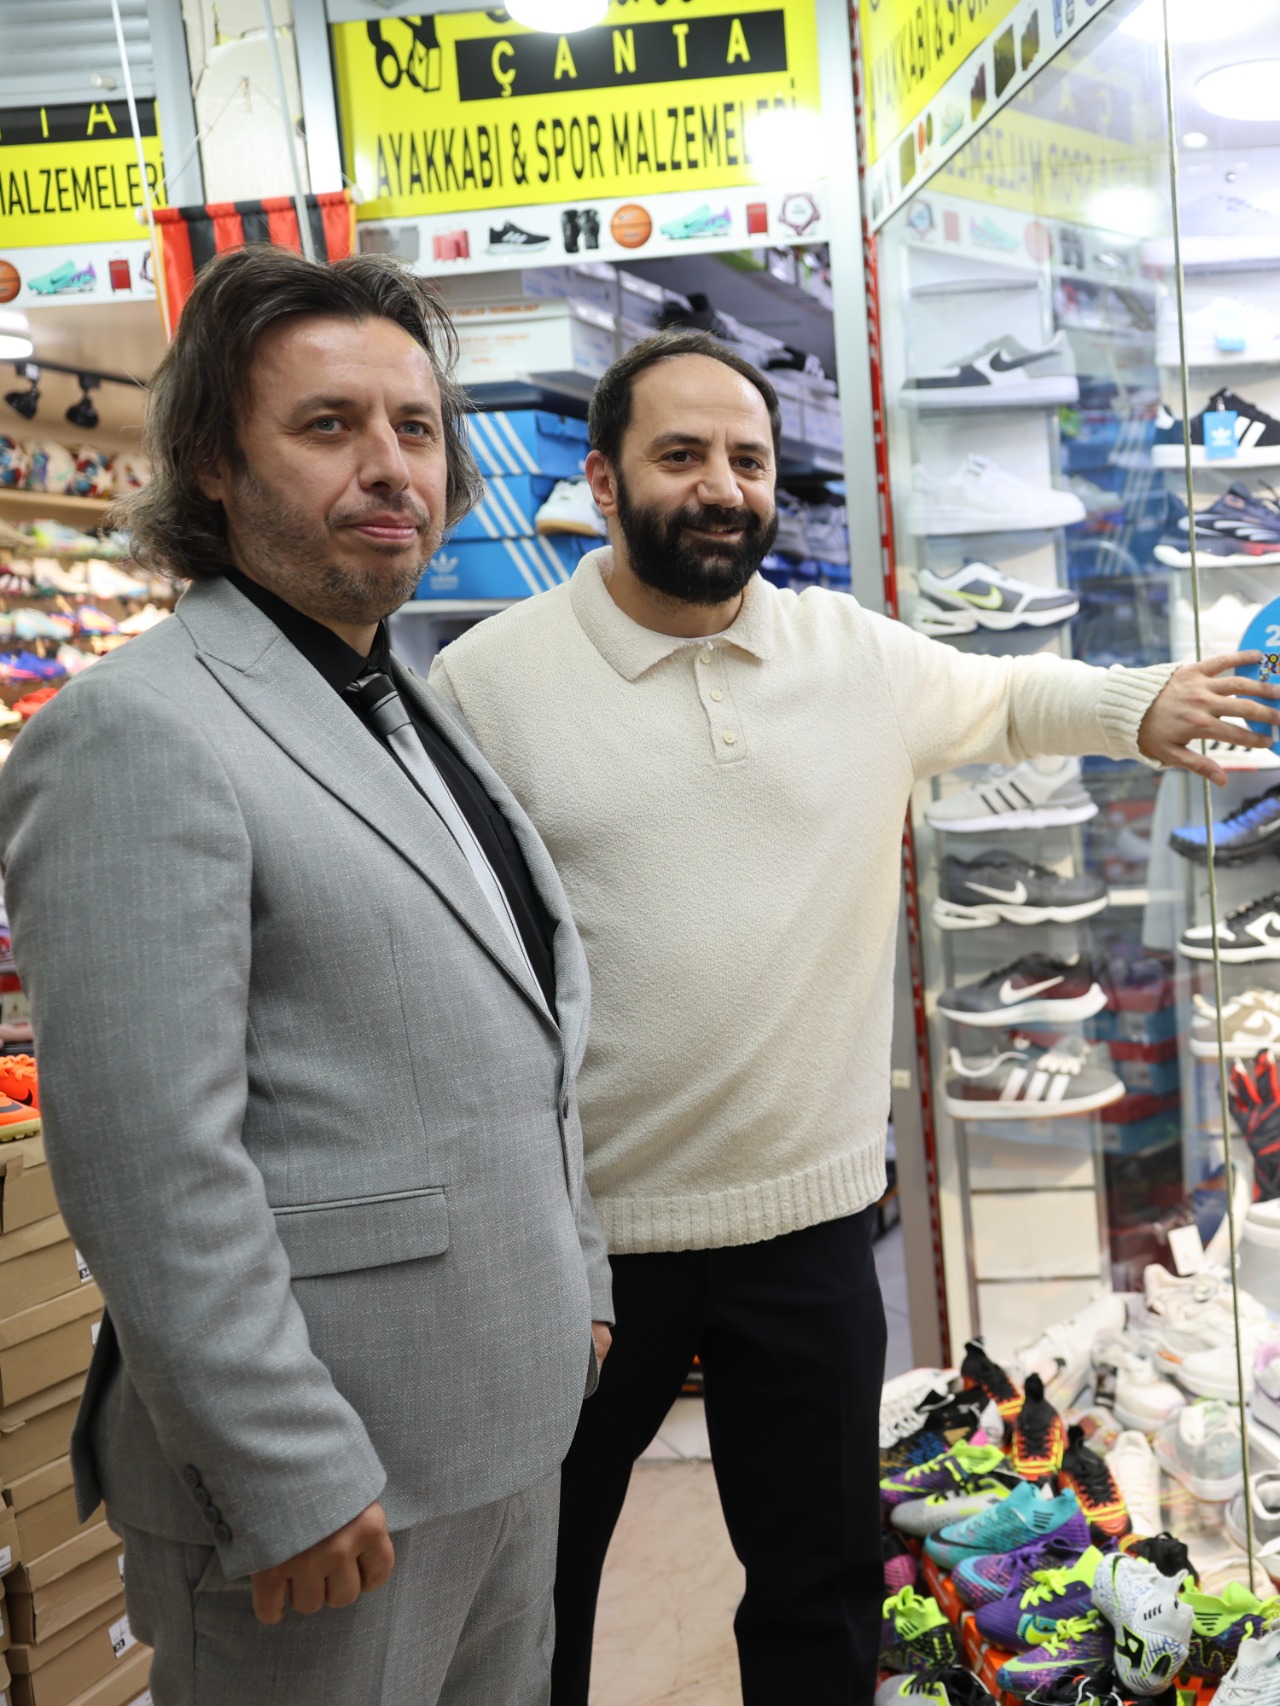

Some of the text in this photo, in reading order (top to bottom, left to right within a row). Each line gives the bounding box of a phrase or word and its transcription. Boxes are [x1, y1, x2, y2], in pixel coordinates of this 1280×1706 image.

[491, 18, 751, 97] ÇANTA
[376, 122, 504, 200] AYAKKABI
[511, 122, 530, 186] &
[535, 114, 604, 183] SPOR
